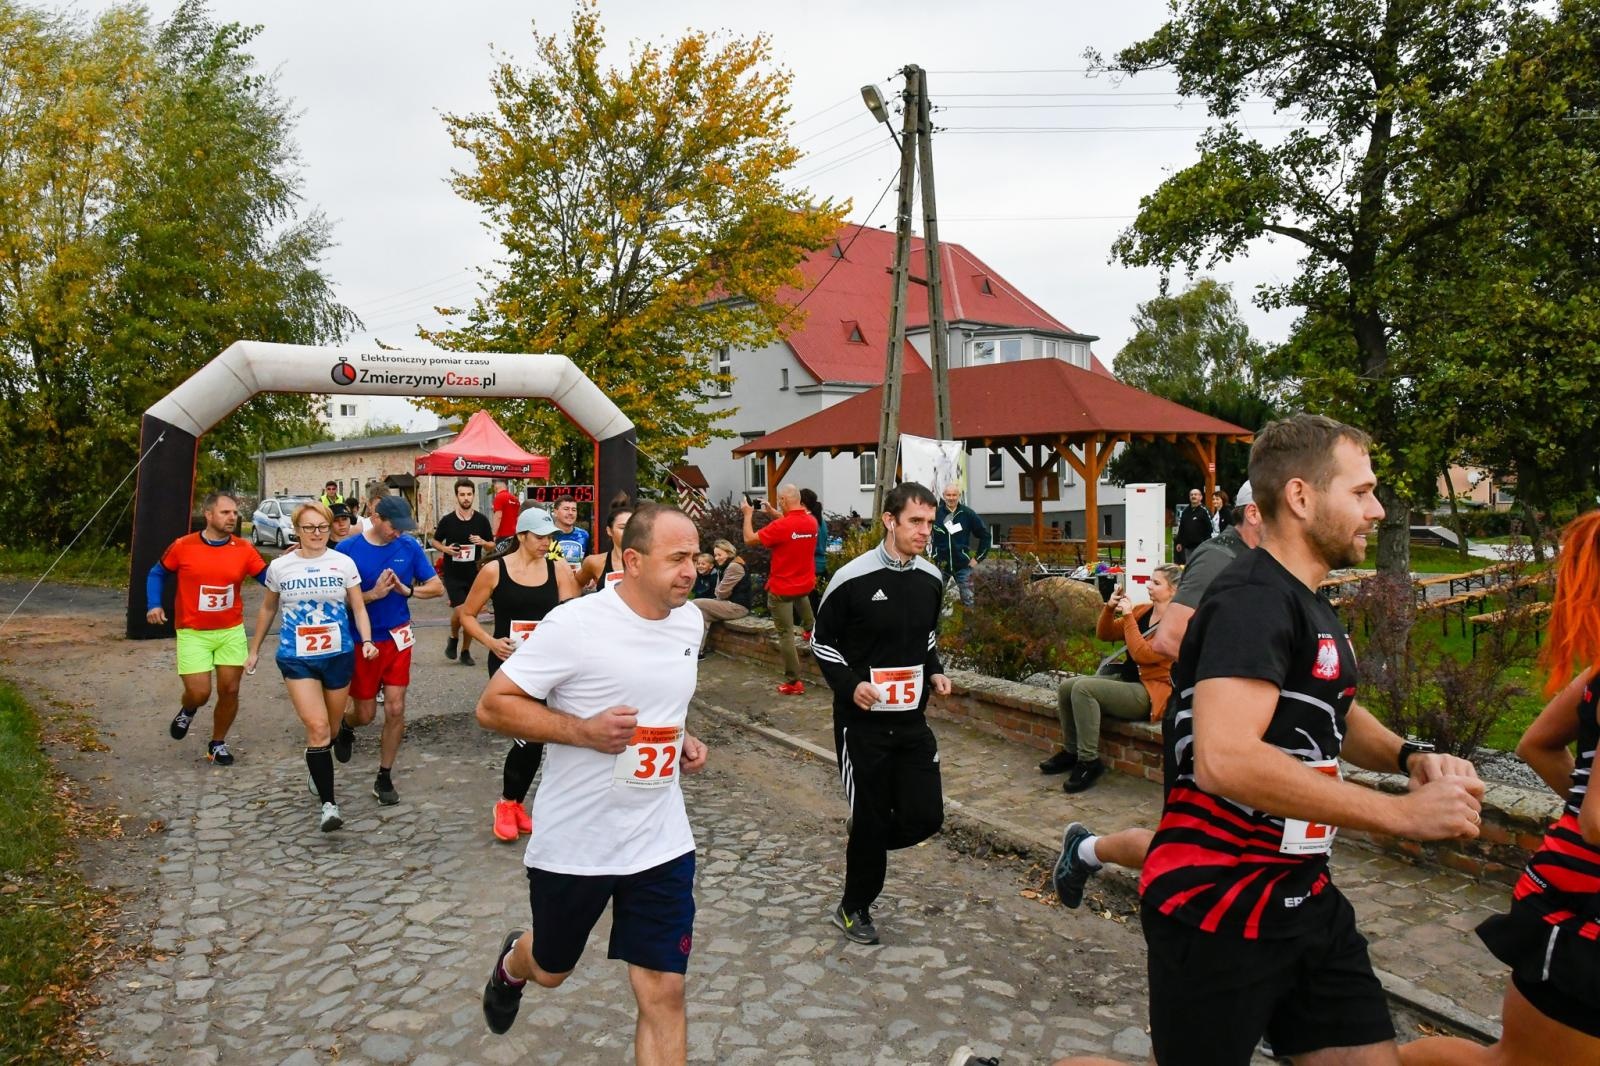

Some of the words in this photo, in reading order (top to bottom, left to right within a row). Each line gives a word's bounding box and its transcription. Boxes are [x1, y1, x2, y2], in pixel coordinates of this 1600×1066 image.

[361, 353, 427, 366] Elektroniczny
[429, 357, 462, 366] pomiar
[359, 369, 496, 389] ZmierzymyCzas.pl
[280, 576, 344, 591] RUNNERS
[207, 595, 228, 608] 31
[305, 634, 332, 652] 22
[885, 682, 916, 705] 15
[633, 745, 677, 779] 32
